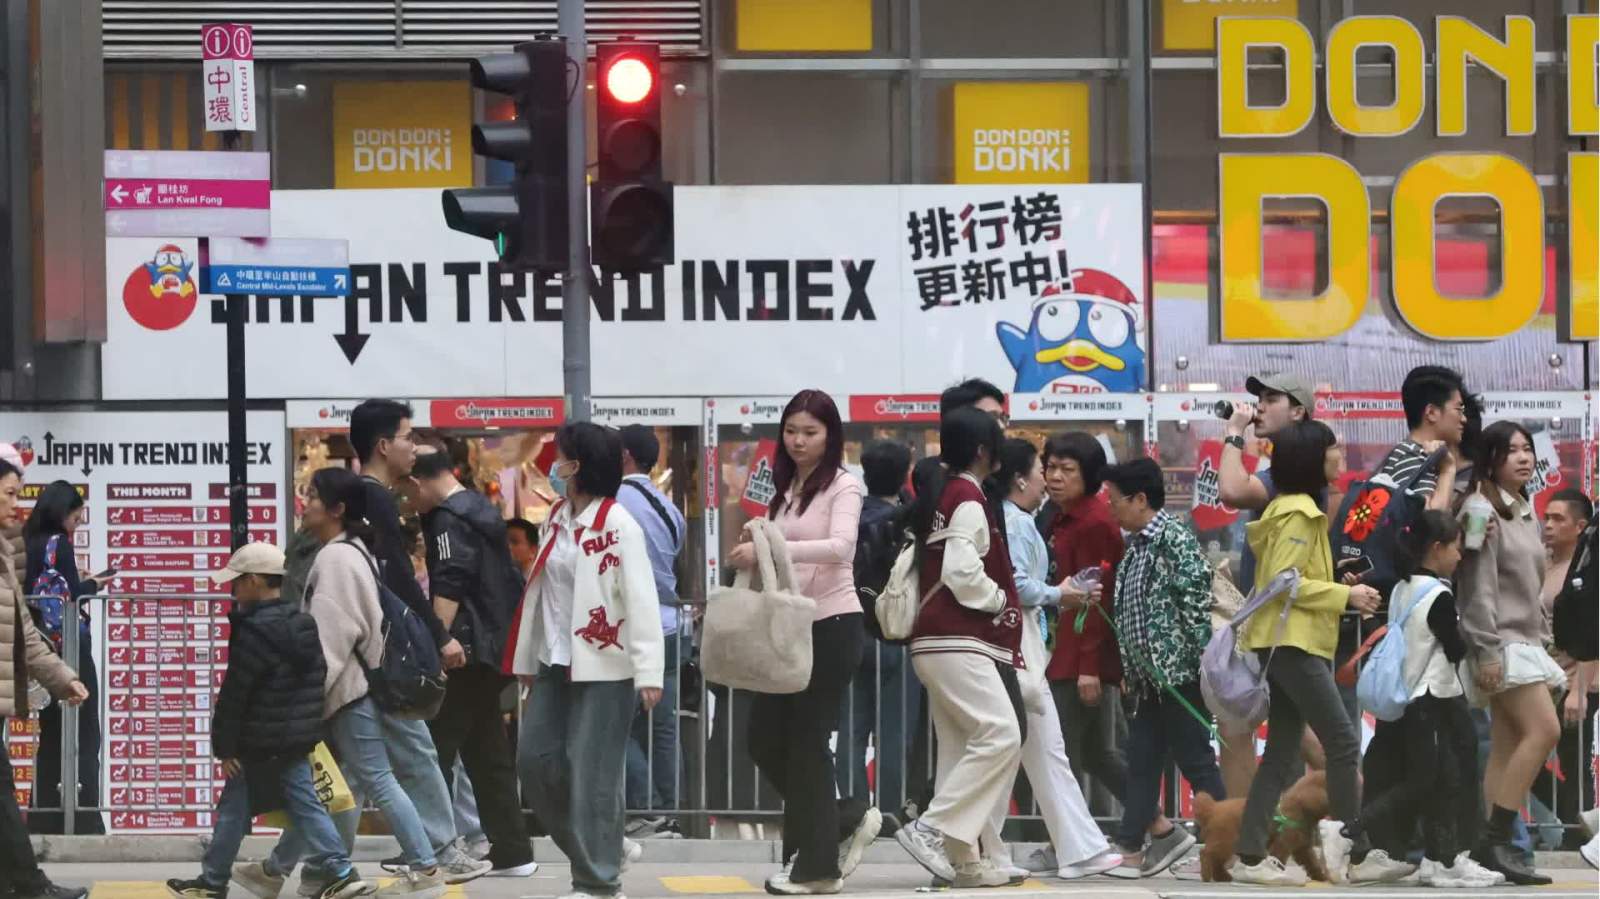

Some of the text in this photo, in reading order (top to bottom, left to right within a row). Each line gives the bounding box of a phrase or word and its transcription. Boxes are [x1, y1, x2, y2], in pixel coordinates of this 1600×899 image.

[1217, 15, 1537, 137] DON
[208, 65, 232, 122] 中環
[239, 65, 248, 123] Central
[353, 128, 396, 145] DON
[974, 128, 1016, 145] DON
[157, 195, 174, 205] Lan
[200, 195, 223, 207] Fong
[907, 191, 1063, 261] 排行榜
[236, 282, 260, 290] Central
[682, 259, 877, 321] INDEX
[621, 407, 648, 416] TREND
[650, 407, 675, 416] INDEX
[916, 403, 940, 412] TREN
[1068, 401, 1096, 411] TREND
[1098, 401, 1122, 410] INDEX
[38, 431, 272, 477] JAPAN TREND INEX
[112, 486, 187, 497] THIS MONTH
[224, 486, 262, 497] SRE
[130, 510, 136, 521] 1
[213, 510, 220, 521] 3
[263, 510, 270, 520] 0
[130, 534, 137, 545] 2
[213, 532, 221, 544] 2
[130, 556, 138, 567] 3
[214, 556, 221, 567] 2
[130, 580, 138, 590] 4
[214, 603, 222, 613] 2
[214, 627, 221, 637] 2
[215, 649, 221, 660] 1
[132, 674, 139, 684] 8
[216, 672, 221, 683] 1
[132, 697, 139, 708] 9
[10, 721, 23, 732] 10
[216, 766, 222, 777] 1
[130, 813, 144, 825] 14
